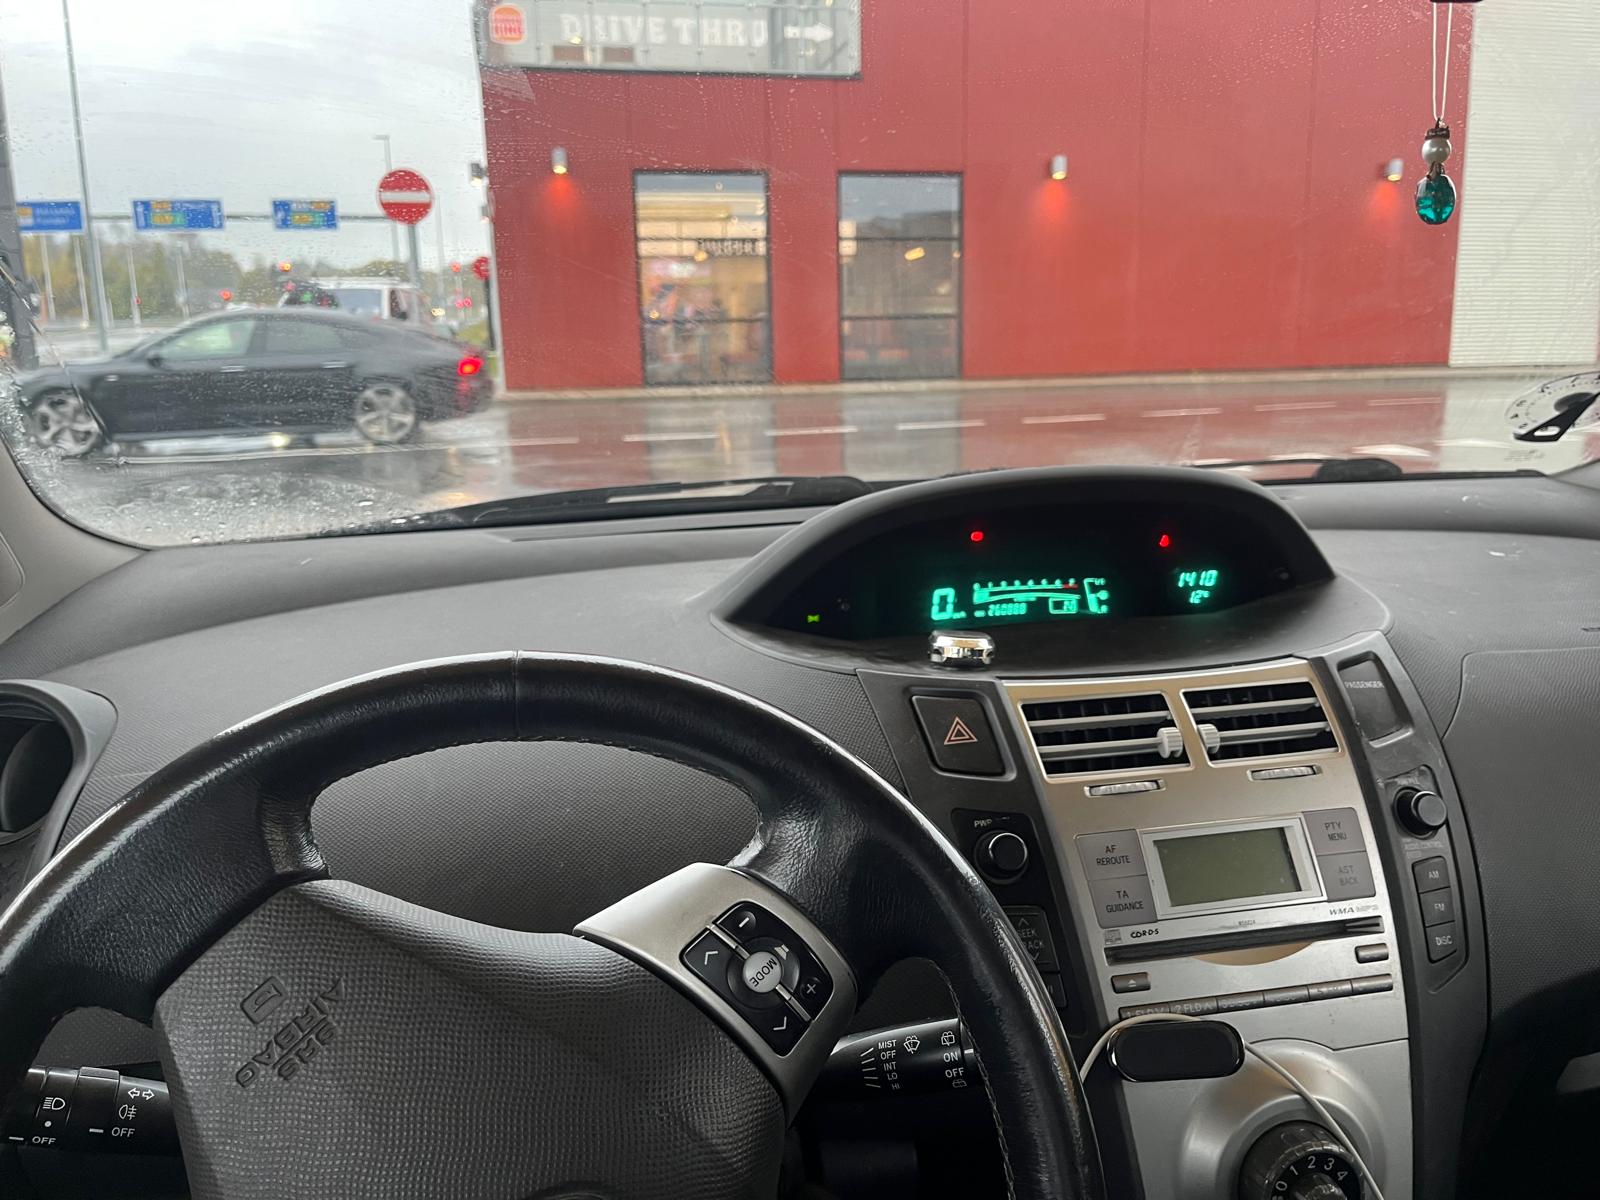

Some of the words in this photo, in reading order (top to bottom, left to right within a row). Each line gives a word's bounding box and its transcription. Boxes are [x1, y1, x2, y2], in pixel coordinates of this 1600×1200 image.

[560, 14, 666, 45] DRIVE
[672, 18, 769, 47] THRU
[931, 587, 956, 621] 0
[1324, 821, 1342, 831] PTY
[1328, 832, 1348, 841] MENU
[1105, 845, 1116, 854] AF
[1096, 855, 1131, 866] REROUTE
[1428, 870, 1440, 880] AM
[1116, 890, 1129, 899] TA
[1105, 901, 1144, 913] GUIDANCE
[1329, 906, 1355, 915] WMA
[1435, 935, 1453, 946] DISC
[749, 957, 778, 988] MODE
[236, 977, 345, 1088] AIRBAG
[878, 1039, 897, 1050] MIST
[880, 1050, 896, 1060] OFF
[943, 1051, 959, 1063] ON
[883, 1061, 897, 1072] INT
[886, 1072, 898, 1081] LO
[945, 1067, 964, 1078] OFF
[112, 1126, 136, 1138] OFF
[31, 1135, 57, 1145] OFF
[1307, 1155, 1316, 1170] 2
[1323, 1157, 1335, 1171] 3
[1289, 1165, 1299, 1177] 1
[1336, 1170, 1349, 1182] 4
[1275, 1180, 1288, 1192] 0
